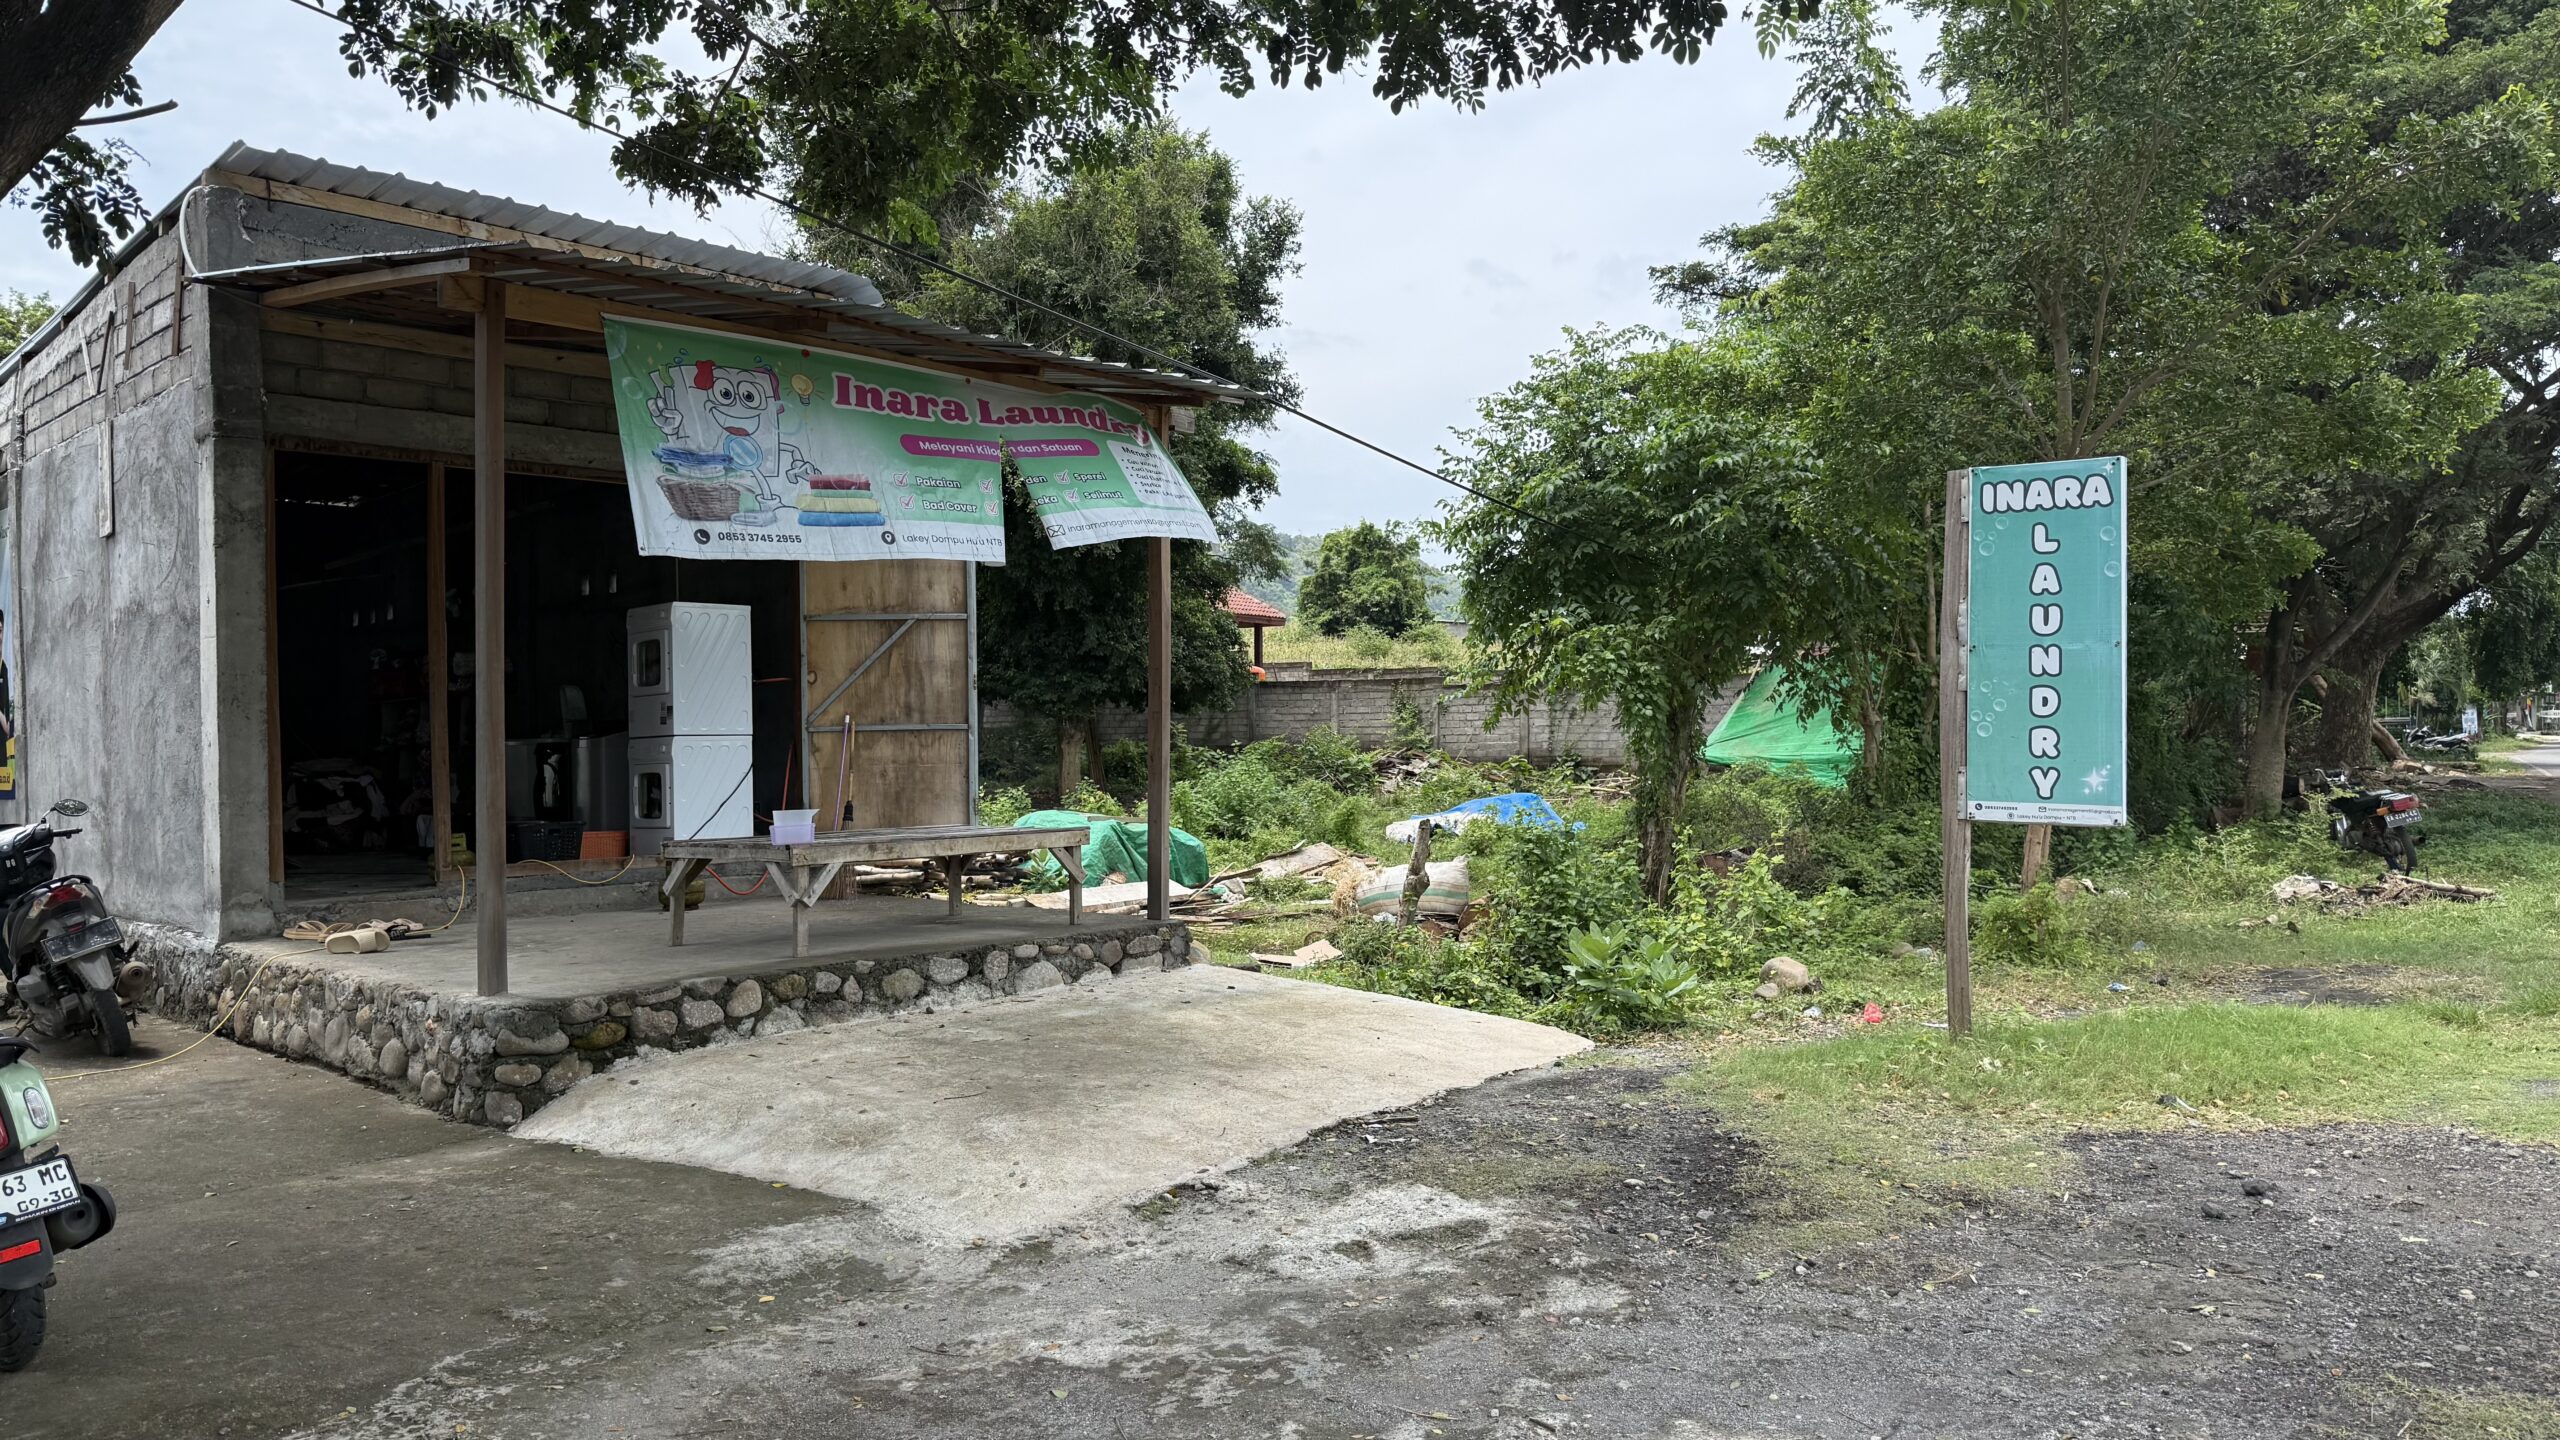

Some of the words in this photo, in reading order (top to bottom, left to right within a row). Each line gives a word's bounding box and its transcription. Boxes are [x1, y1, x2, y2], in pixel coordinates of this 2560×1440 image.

[832, 372, 972, 425] Inara
[976, 398, 1151, 446] Laundry
[918, 441, 975, 454] Melayani
[1017, 445, 1040, 453] dan
[1041, 444, 1083, 452] Satuan
[915, 476, 961, 488] Pakaian
[1073, 472, 1107, 483] Sperei
[1083, 490, 1123, 500] Selimut
[1980, 474, 2114, 514] INARA
[922, 500, 944, 511] Bad
[945, 501, 977, 513] Cover
[718, 532, 745, 541] 0853
[748, 533, 774, 543] 3745
[775, 534, 802, 543] 2955
[902, 534, 930, 545] Lakey
[931, 535, 965, 546] Dompu
[986, 538, 1003, 547] NTB
[2029, 522, 2063, 800] LAUNDRY
[2, 1175, 27, 1197] 63
[37, 1163, 67, 1186] MC
